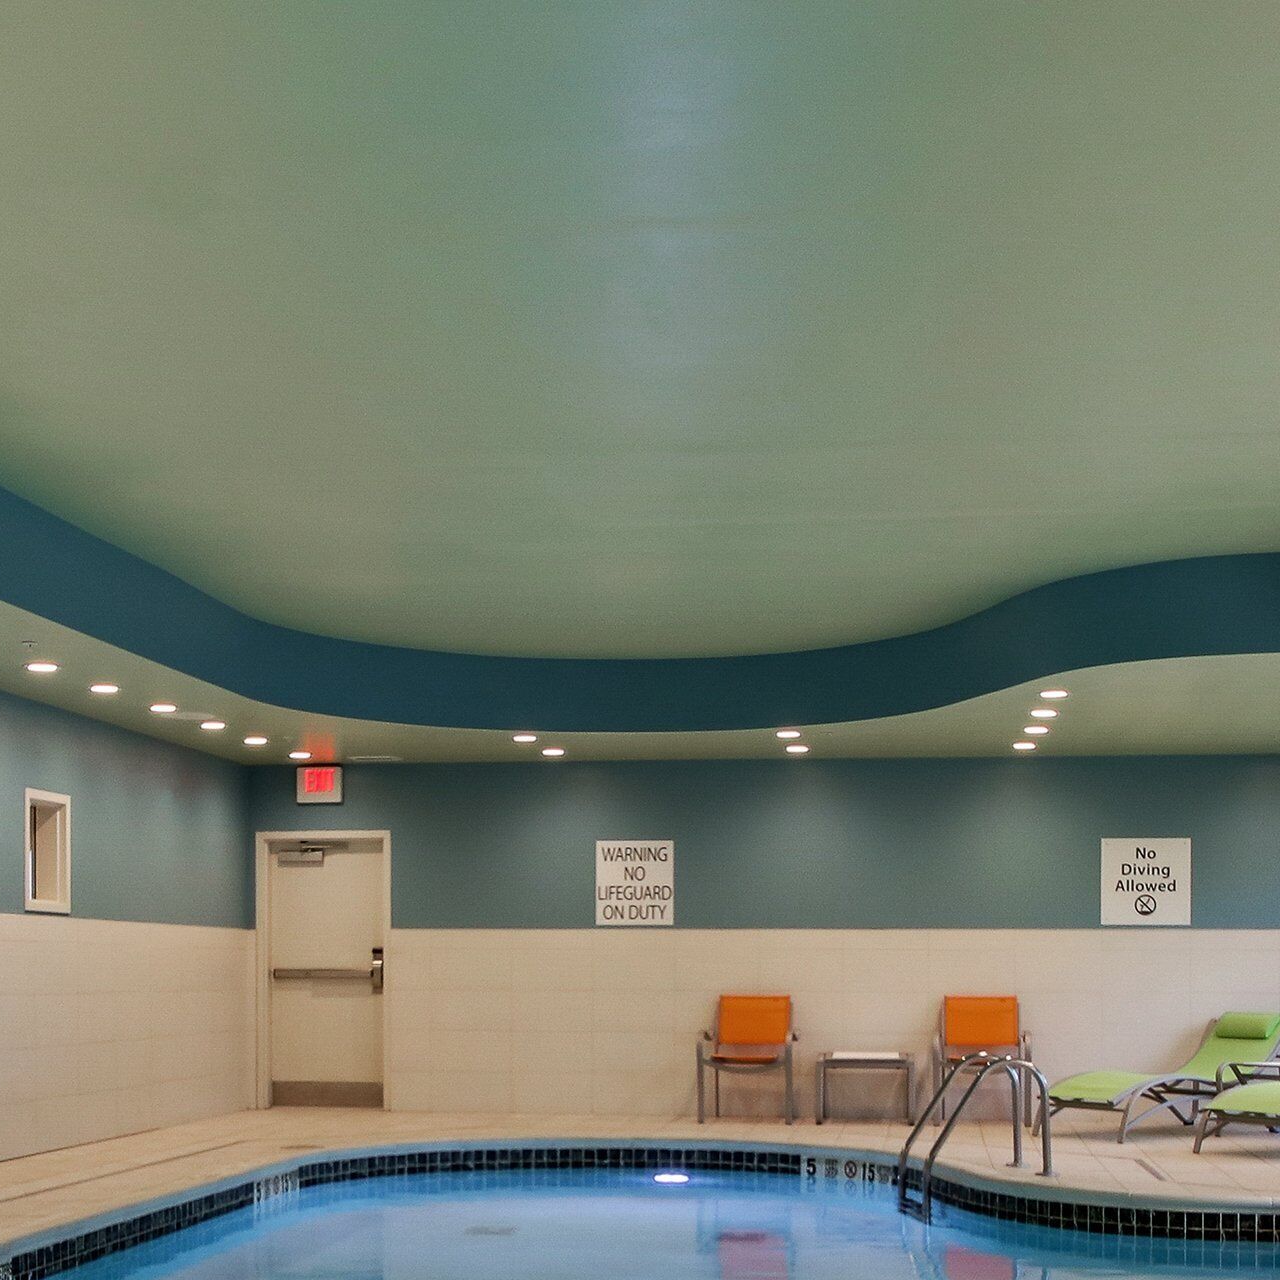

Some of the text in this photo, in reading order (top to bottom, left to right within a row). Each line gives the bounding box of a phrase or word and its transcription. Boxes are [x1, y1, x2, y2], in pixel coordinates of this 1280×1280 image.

[304, 769, 335, 792] EXIT
[601, 847, 668, 862] WARNING
[1135, 847, 1157, 860] No
[624, 866, 646, 881] NO
[1121, 863, 1171, 879] Diving
[598, 885, 672, 901] LIFEGUARD
[1114, 879, 1177, 893] Allowed
[603, 905, 668, 920] ON DUTY
[806, 1158, 817, 1176] 5
